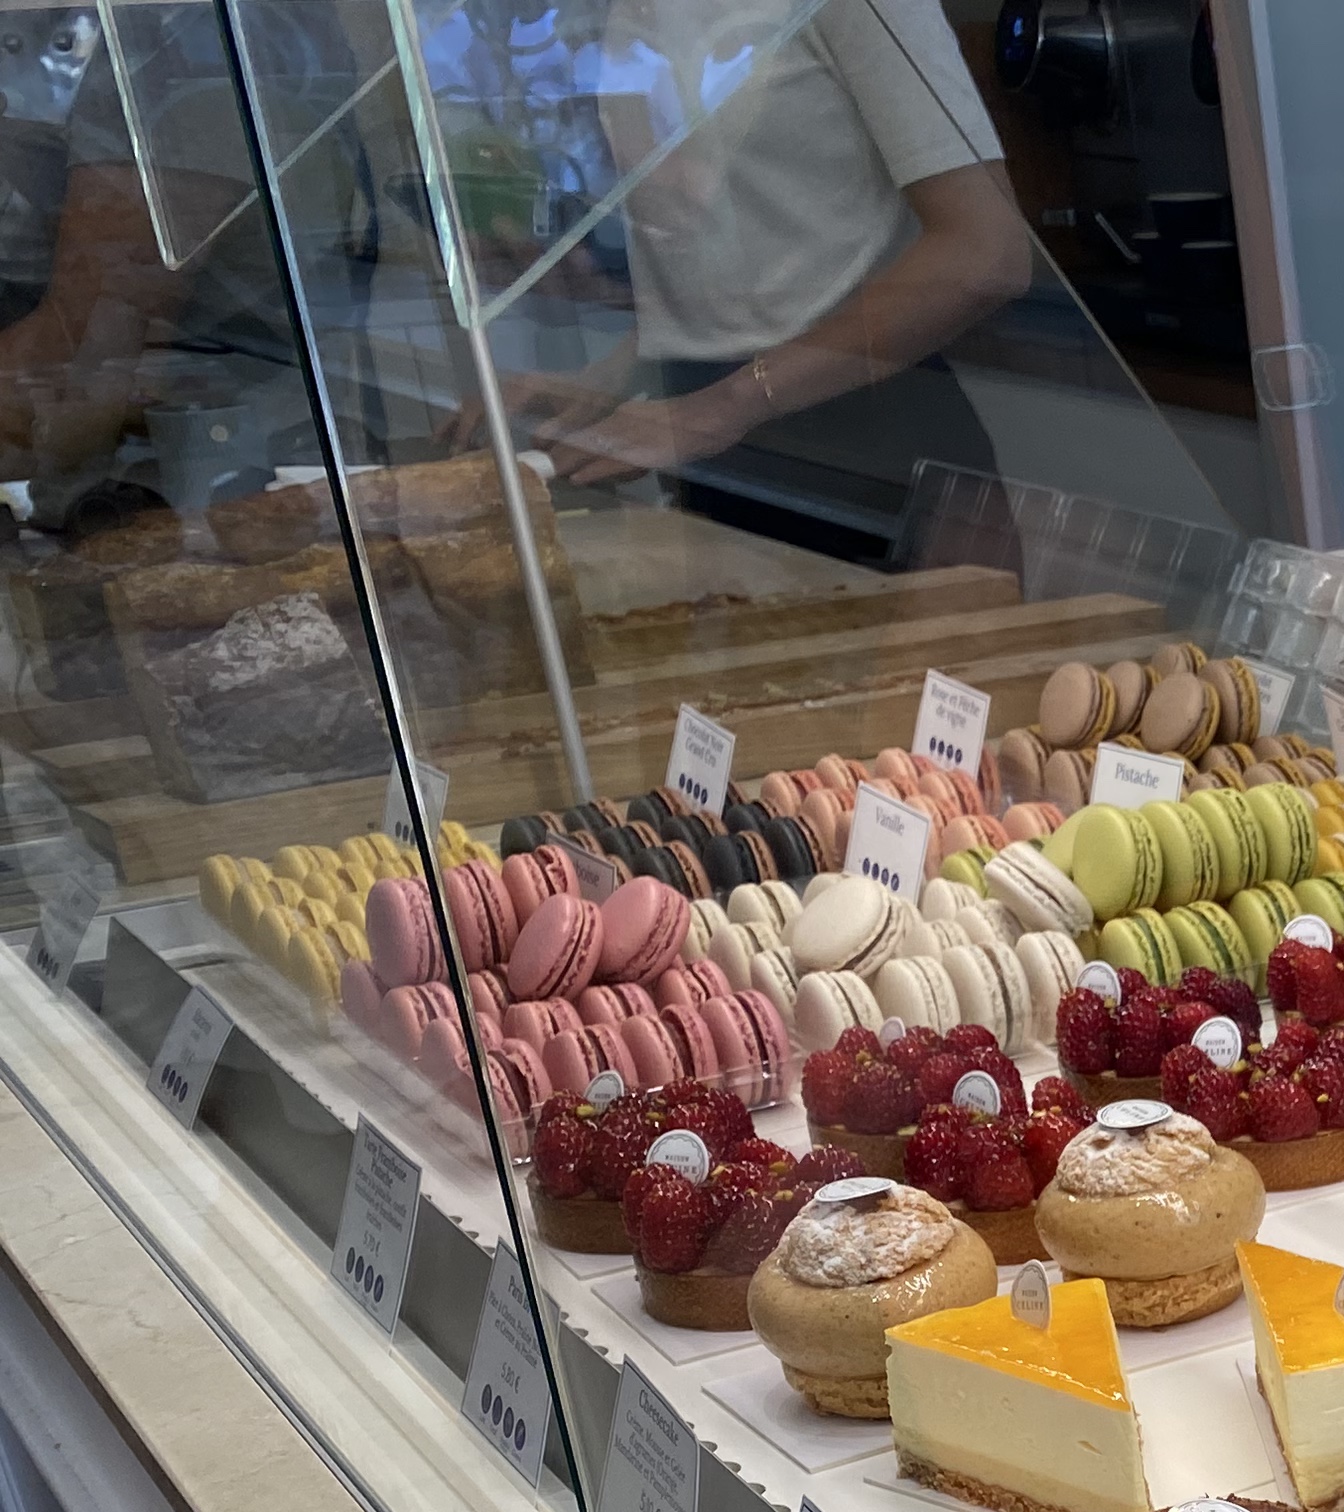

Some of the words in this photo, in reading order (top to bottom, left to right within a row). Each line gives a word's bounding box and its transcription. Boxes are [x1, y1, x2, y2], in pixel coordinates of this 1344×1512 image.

[1115, 762, 1160, 790] Pistache
[876, 805, 905, 836] Vanille
[1016, 1301, 1044, 1311] CELINE
[639, 1389, 679, 1447] Cheesecake
